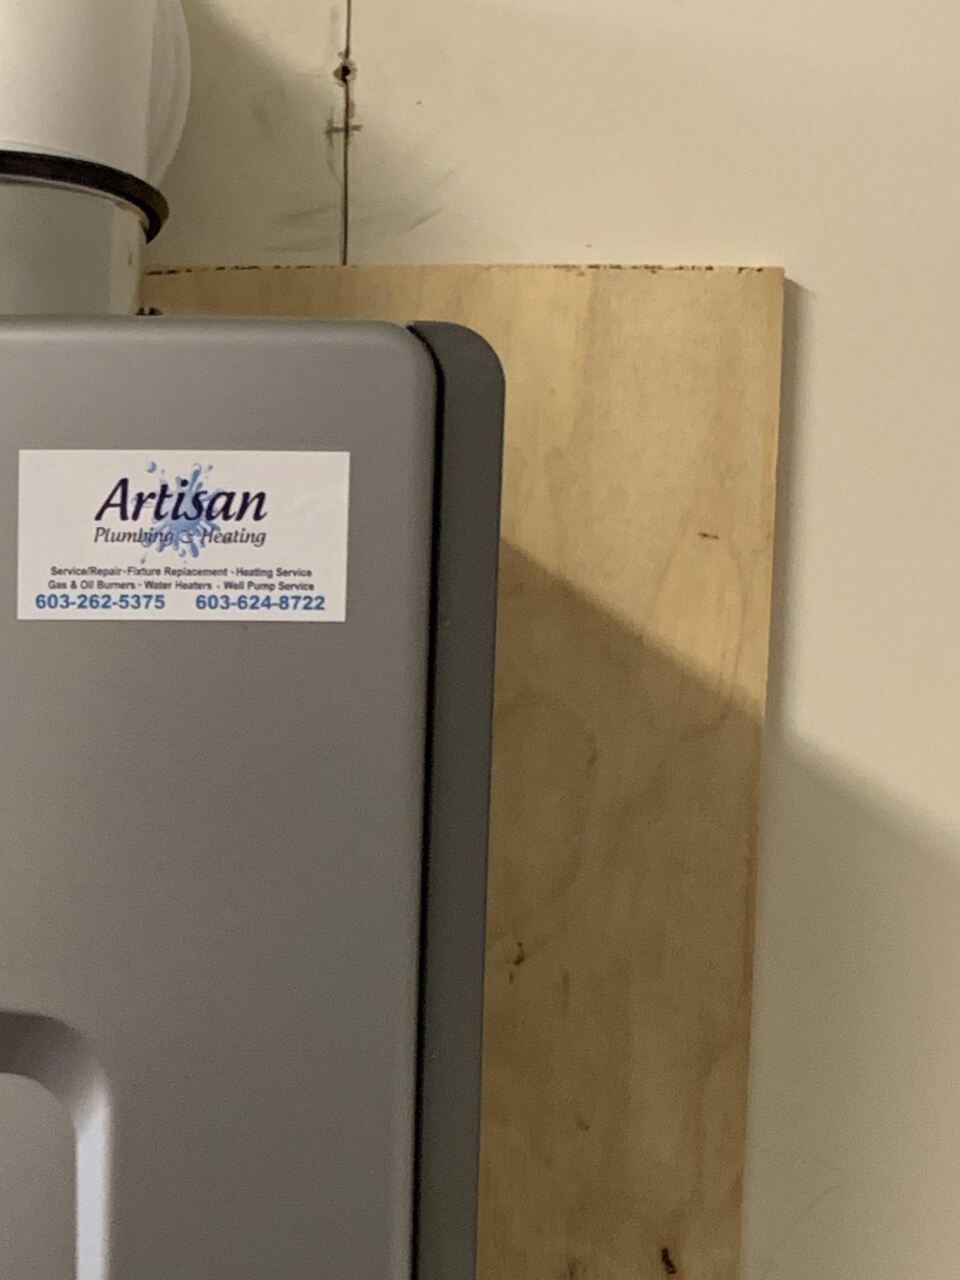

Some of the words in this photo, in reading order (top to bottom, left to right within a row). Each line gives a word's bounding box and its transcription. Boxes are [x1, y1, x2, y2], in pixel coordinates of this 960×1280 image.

[95, 478, 267, 521] Artisan
[94, 528, 174, 547] Plumbing
[201, 528, 267, 548] Heating
[164, 567, 228, 578] Replacement
[236, 567, 273, 579] Heating
[276, 568, 313, 578] Service
[48, 580, 67, 590] Gas
[70, 580, 78, 590] &
[80, 580, 94, 590] Oil
[97, 580, 136, 590] Burners
[144, 580, 172, 590] Water
[175, 581, 212, 590] Heaters
[224, 581, 245, 590] Well
[247, 581, 276, 592] Pump
[278, 581, 315, 591] Service
[35, 594, 165, 609] 603-262-5375
[195, 595, 325, 611] 603-624-8722
